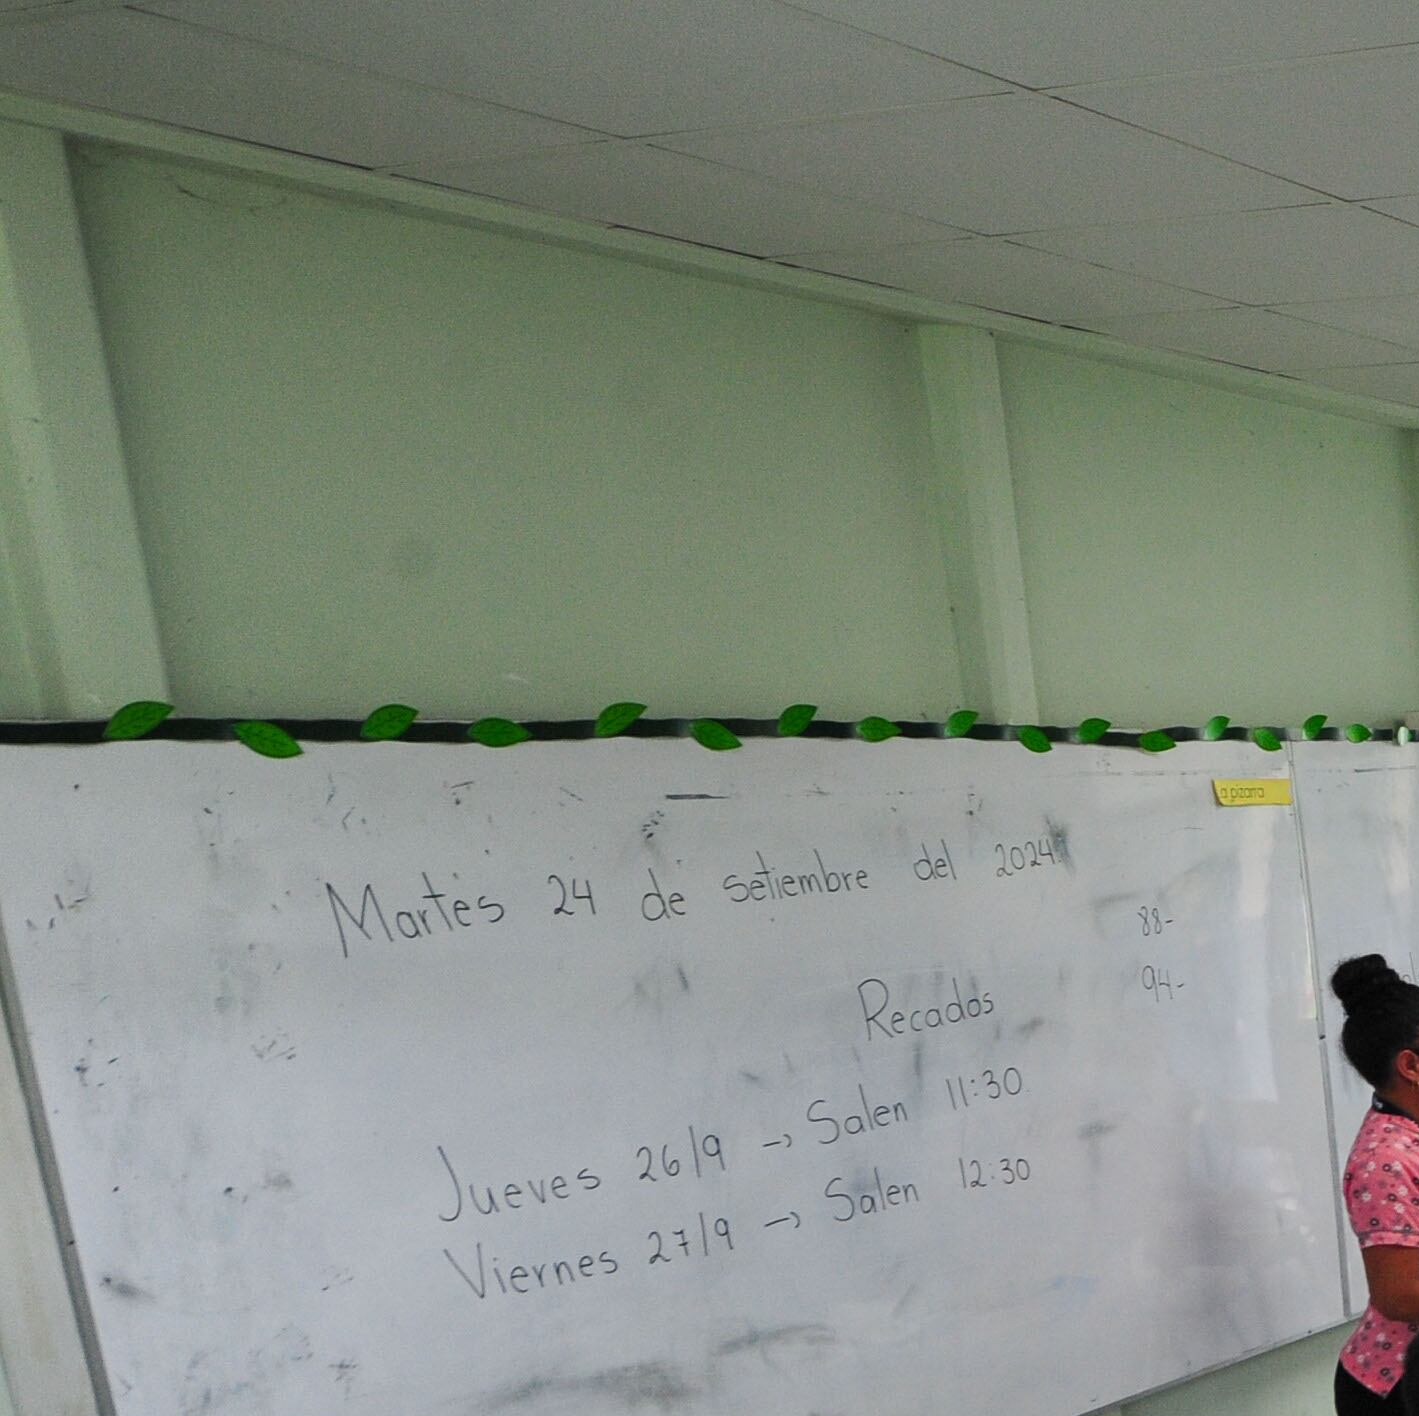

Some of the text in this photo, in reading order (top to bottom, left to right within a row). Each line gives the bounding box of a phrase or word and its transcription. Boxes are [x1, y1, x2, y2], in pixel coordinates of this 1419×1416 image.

[325, 873, 506, 960] Martes
[547, 873, 597, 920] 24
[640, 868, 688, 923] de
[723, 850, 871, 904] setiembre
[913, 840, 956, 882] del
[857, 976, 995, 1042] Recados
[437, 1065, 1023, 1223] Jueves 26/9 Salen 11:30
[443, 1157, 1031, 1300] Viernes 27/9 Salen 12:30
